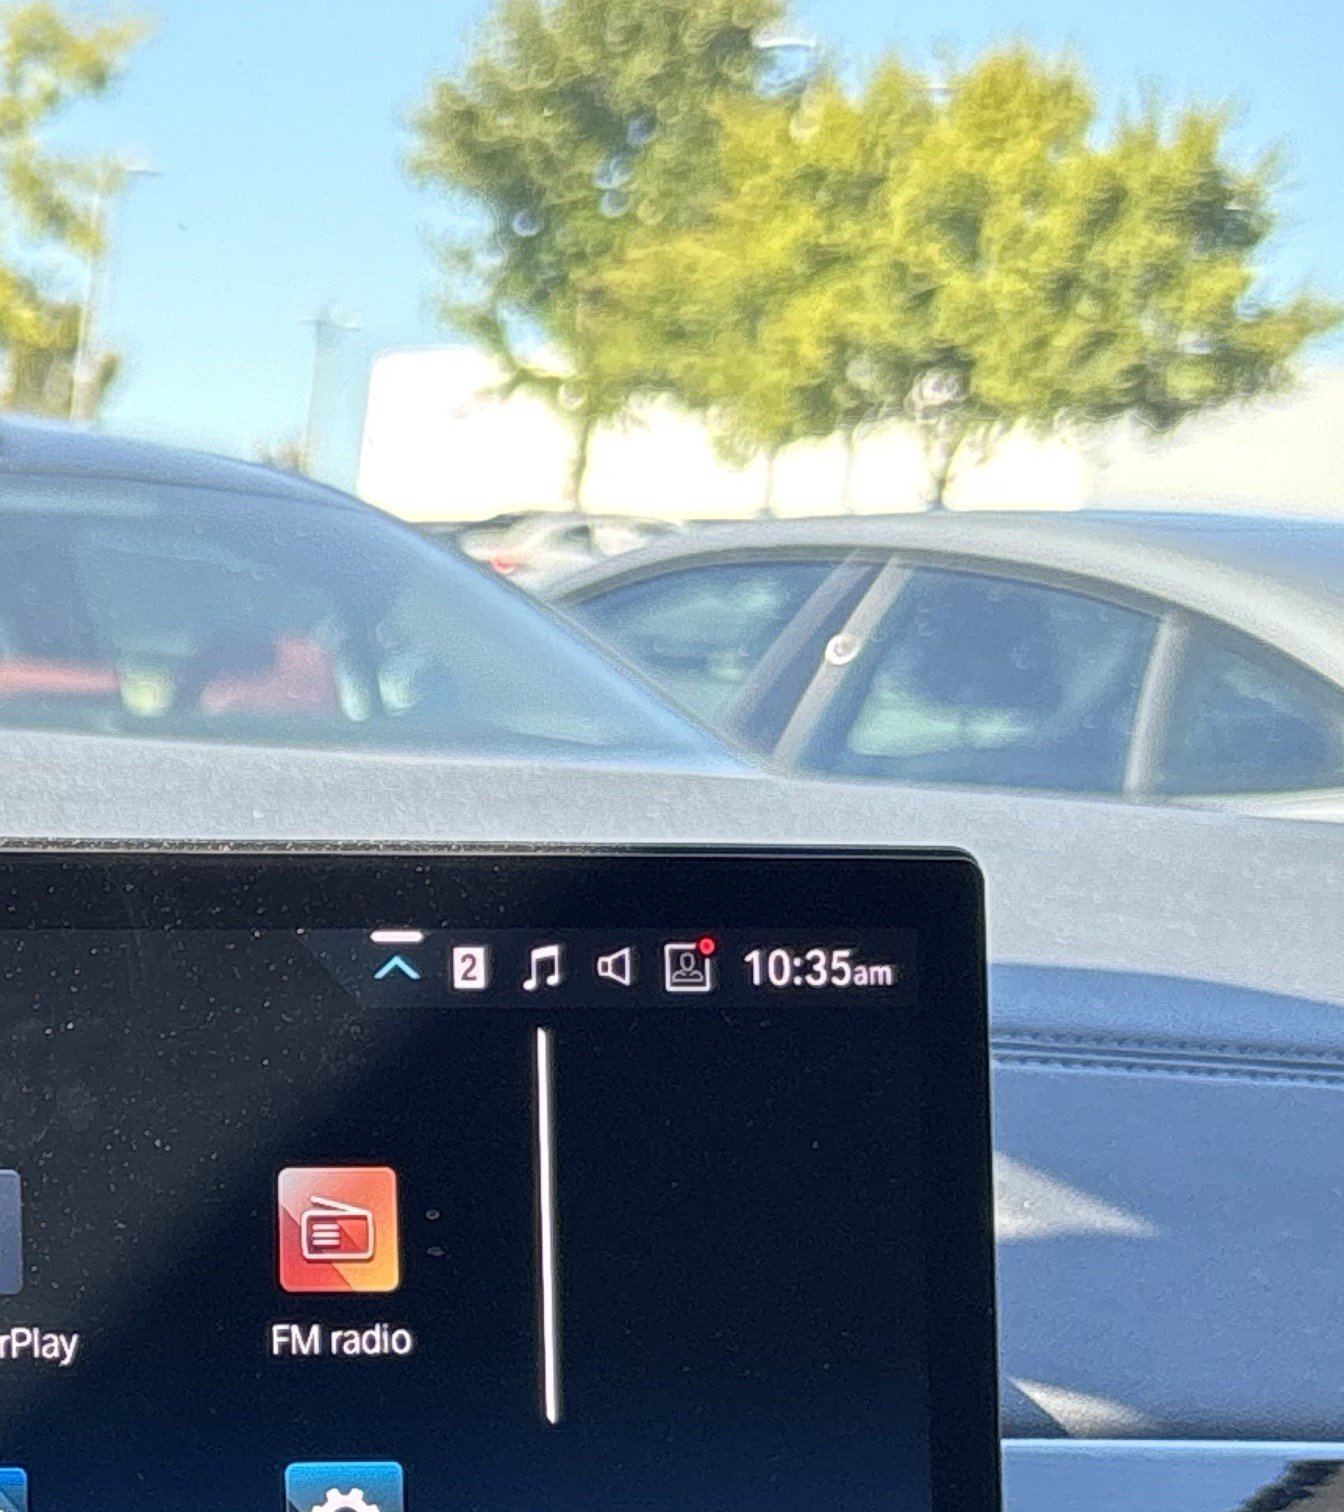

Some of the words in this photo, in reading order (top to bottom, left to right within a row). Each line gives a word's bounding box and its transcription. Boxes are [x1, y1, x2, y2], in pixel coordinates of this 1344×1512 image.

[460, 951, 478, 982] 2
[272, 1325, 320, 1354] FM
[331, 1324, 411, 1354] radio
